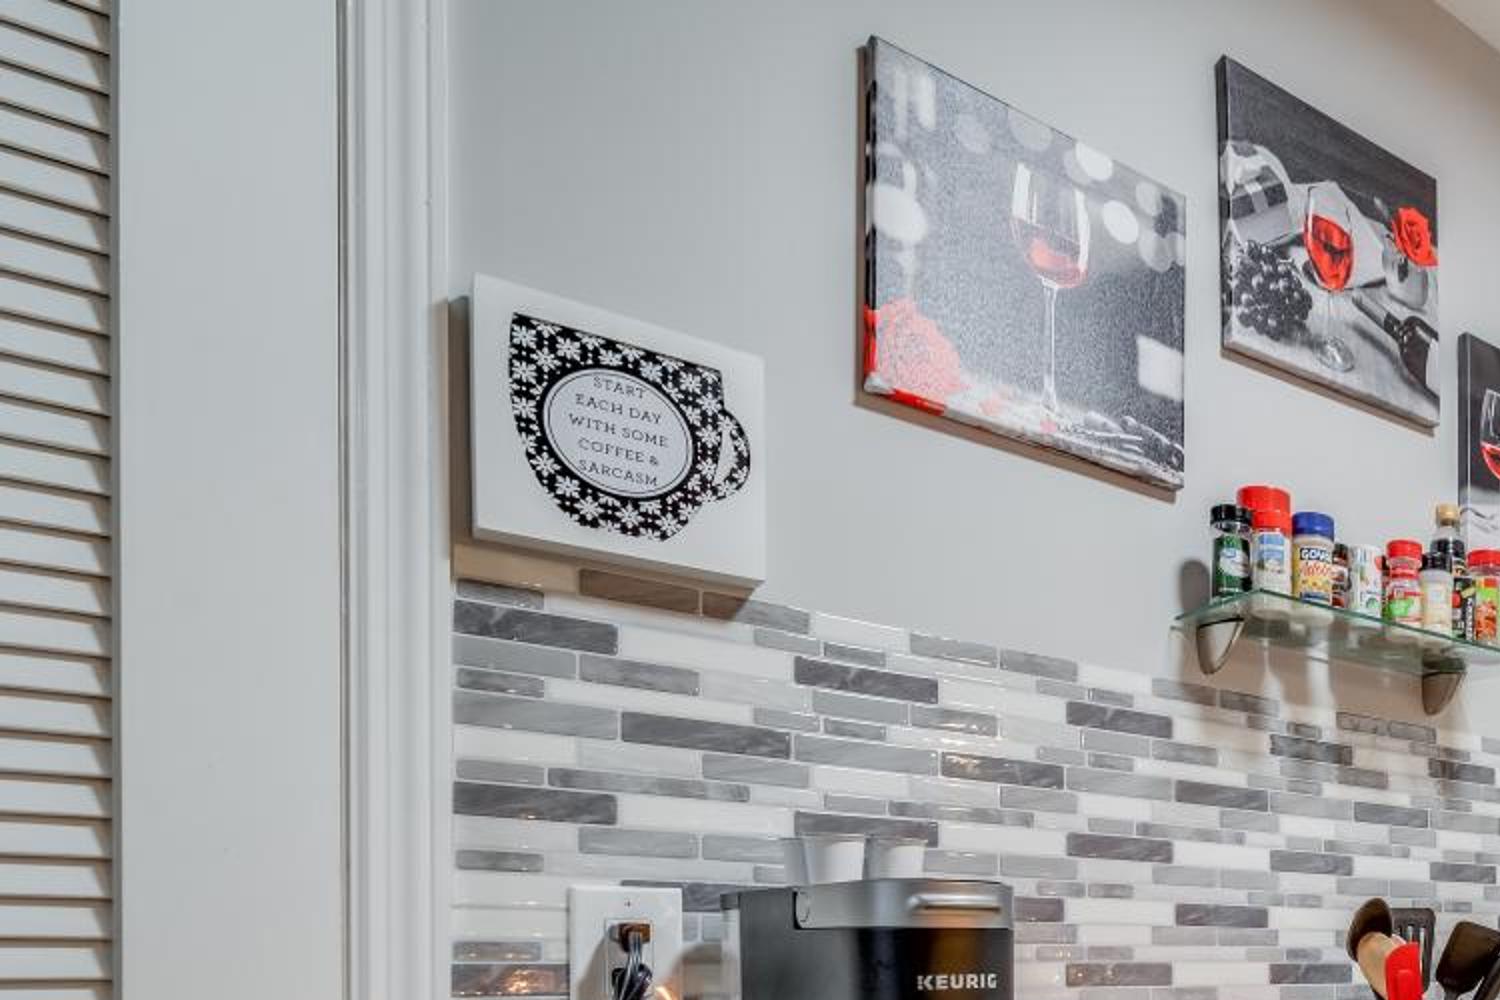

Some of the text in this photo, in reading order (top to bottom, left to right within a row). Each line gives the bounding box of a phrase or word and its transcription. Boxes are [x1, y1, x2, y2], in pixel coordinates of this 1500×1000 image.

[593, 376, 645, 398] START
[575, 394, 661, 424] EACH DAY
[569, 413, 668, 448] WITH SOME
[579, 438, 658, 465] COFFEE &
[579, 460, 657, 486] SARCASM
[917, 973, 997, 991] KEURIG
